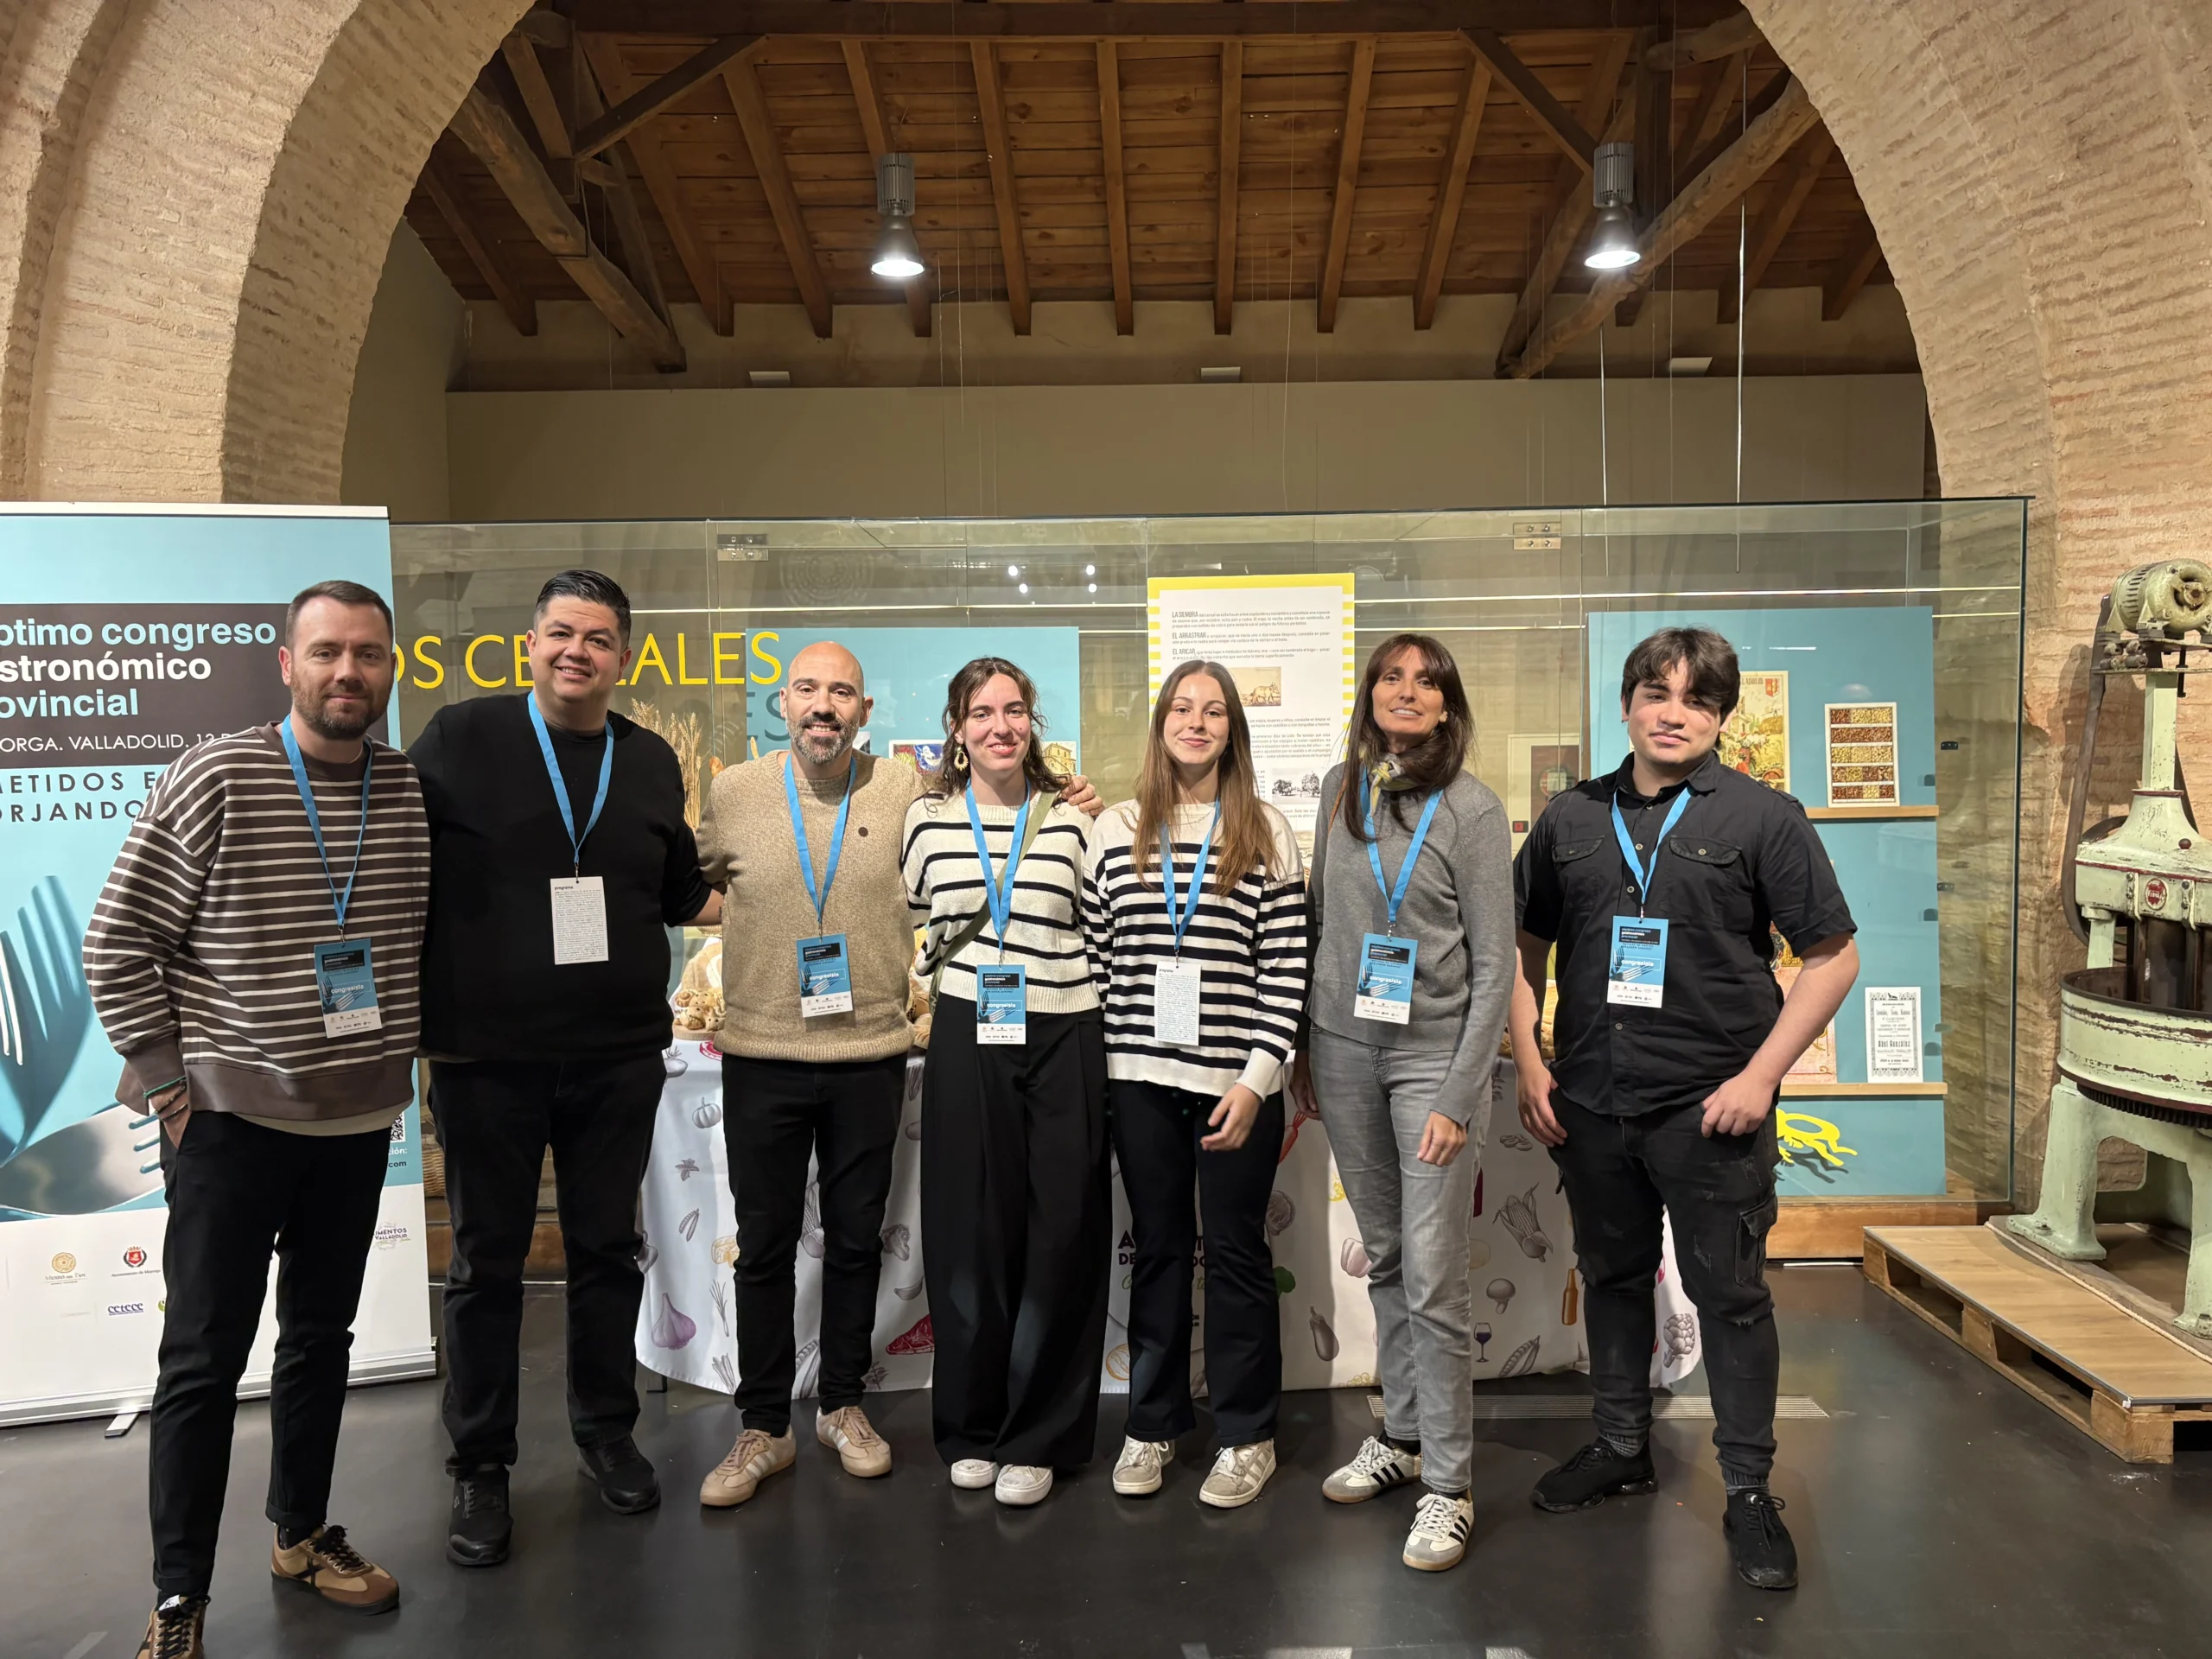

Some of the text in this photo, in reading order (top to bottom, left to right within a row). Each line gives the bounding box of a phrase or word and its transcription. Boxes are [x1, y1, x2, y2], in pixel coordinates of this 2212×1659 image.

[101, 623, 276, 652] congreso
[0, 651, 212, 682] stronómico
[465, 632, 782, 688] CEALES
[0, 688, 138, 718] ovincial
[68, 734, 189, 750] VALLADOLID.
[0, 772, 124, 793] ETIDOS
[0, 800, 143, 822] RJANDO
[809, 972, 840, 981] congresista
[1370, 975, 1402, 985] congresista
[331, 984, 365, 995] congresista
